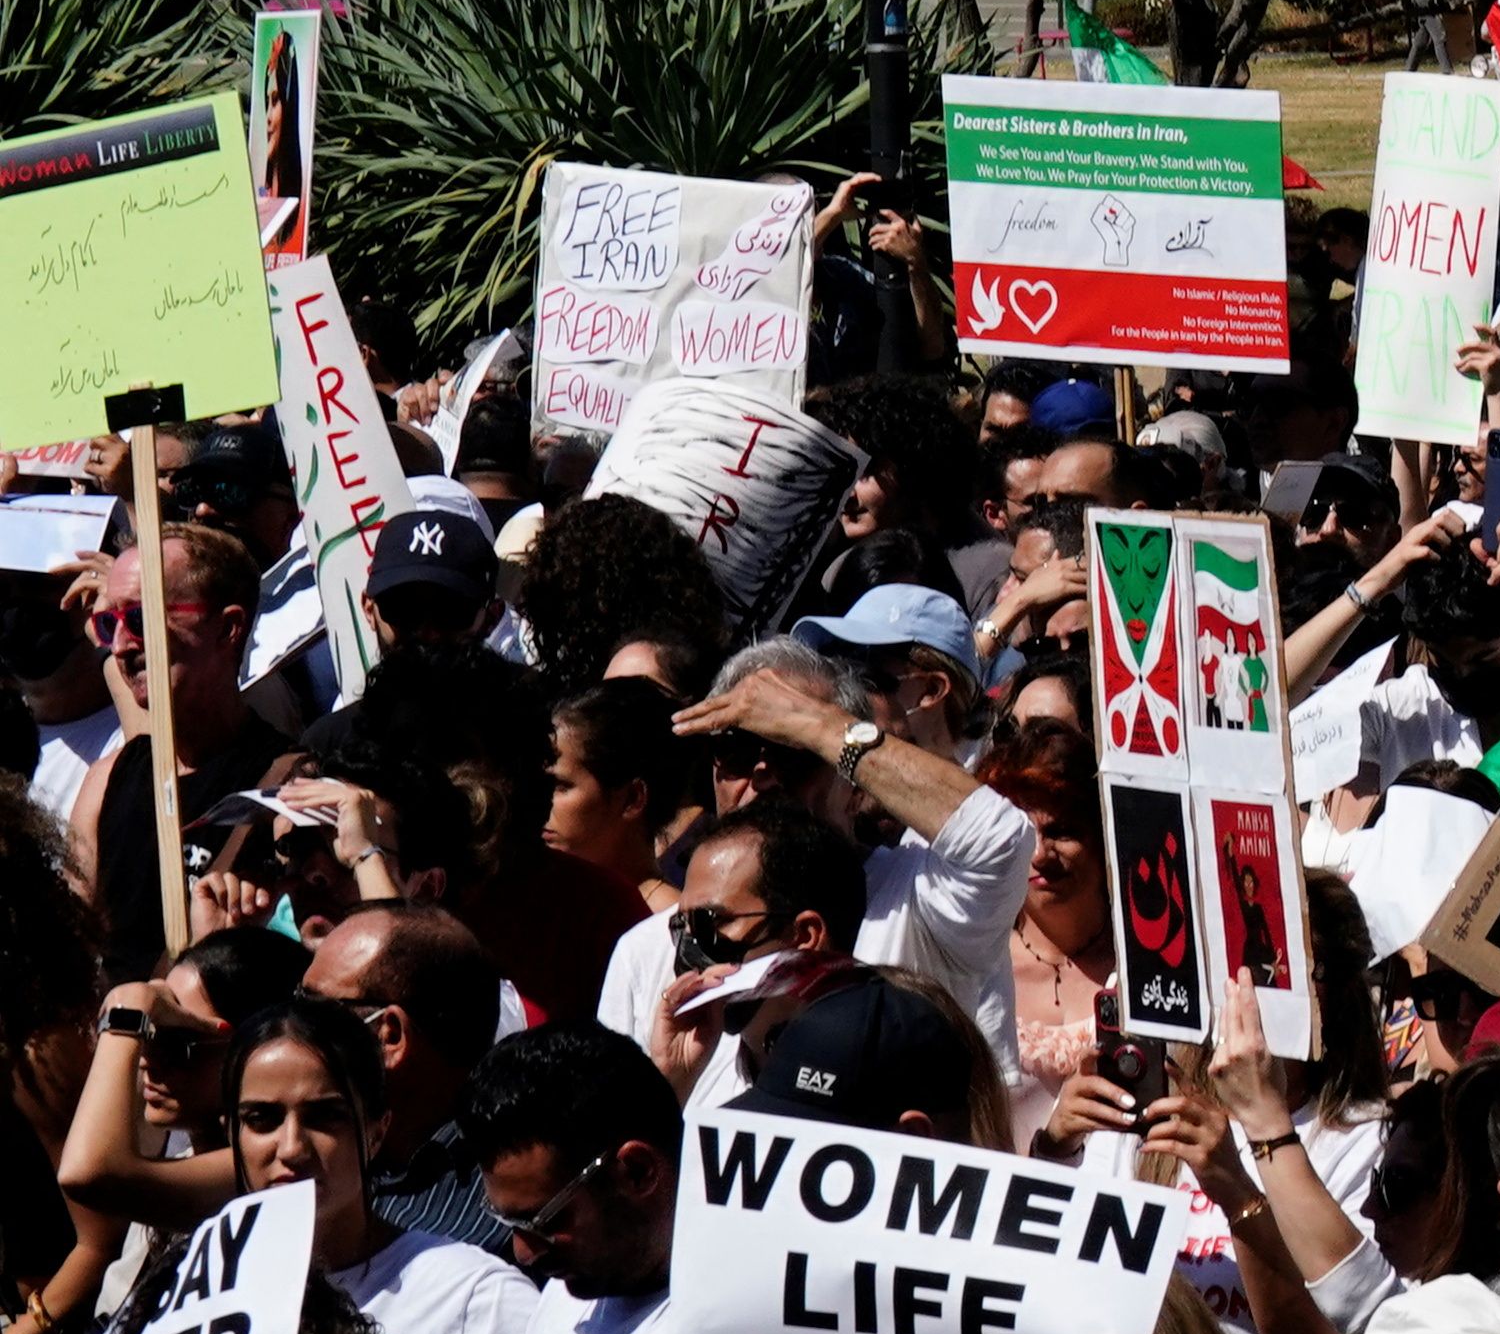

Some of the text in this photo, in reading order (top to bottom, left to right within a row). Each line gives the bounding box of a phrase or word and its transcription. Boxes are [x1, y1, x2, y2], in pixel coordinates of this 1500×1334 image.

[953, 112, 1188, 144] Dearest Sisters & Brothers in Iran,
[1384, 84, 1500, 164] STAND
[979, 145, 1248, 174] We See You and Your Bravery. We Stand with You.
[976, 164, 1254, 194] We Love You. We Pray for Your Protection & Victory.
[562, 180, 682, 246] FREE
[987, 199, 1059, 254] freedom
[1164, 215, 1215, 259] آزادی
[571, 237, 669, 283] IRAN
[1173, 287, 1282, 307] No Islamic Religious Rule.
[1225, 304, 1283, 322] No Monarchy.
[537, 286, 654, 357] FREEDOM
[1111, 325, 1284, 347] For the People in Iran by the People in Iran.
[1183, 316, 1283, 334] No Foreign Intervention.
[680, 312, 800, 365] WOMEN
[546, 367, 633, 428] EQUALI
[408, 521, 446, 556] NY
[1237, 809, 1271, 834] MAHSA
[1239, 834, 1272, 858] AMINI
[796, 1066, 837, 1091] EA7
[698, 1124, 1166, 1276] WOMEN
